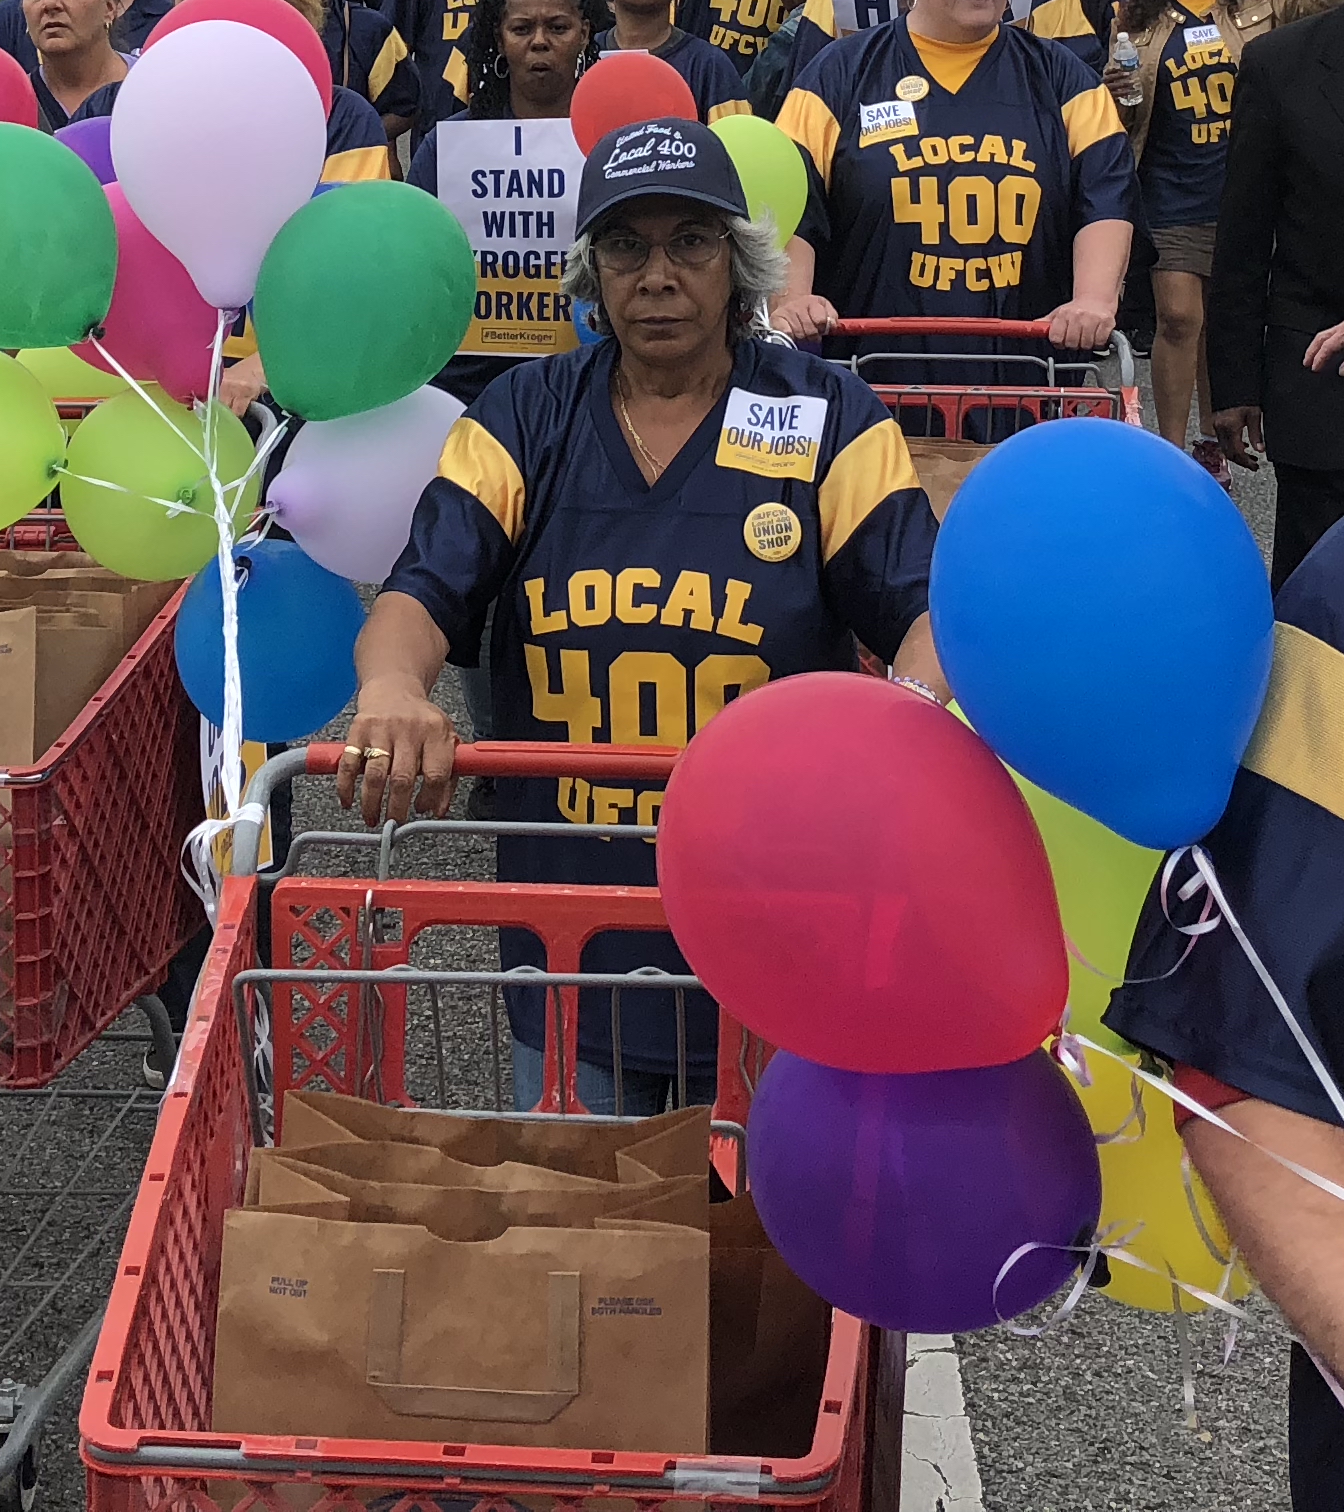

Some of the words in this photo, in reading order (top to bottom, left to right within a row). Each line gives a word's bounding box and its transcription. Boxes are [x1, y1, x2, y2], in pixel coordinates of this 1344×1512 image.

[1192, 29, 1215, 40] SAVE
[1165, 48, 1234, 78] LOCA
[1170, 71, 1235, 118] 40
[861, 122, 882, 137] OUR
[884, 117, 913, 130] JOBS!
[866, 105, 901, 123] SAVE
[514, 126, 522, 156] I
[1191, 119, 1231, 144] UF
[603, 137, 656, 170] Local
[657, 139, 696, 158] 400
[889, 134, 1036, 173] LOCAL
[471, 168, 565, 199] STAND
[605, 161, 657, 179] Commercial
[657, 159, 695, 171] Workers
[482, 211, 555, 238] WITH
[890, 175, 1042, 245] 400
[473, 250, 568, 279] ROGE
[909, 251, 1023, 292] UFCW
[474, 291, 572, 321] ORKER
[747, 402, 802, 431] SAVE
[727, 426, 763, 452] OUR
[766, 433, 813, 457] JOBS!
[753, 522, 793, 539] UNION
[758, 535, 792, 550] SHOP
[524, 567, 764, 645] LOCAL
[289, 1288, 307, 1298] OUT
